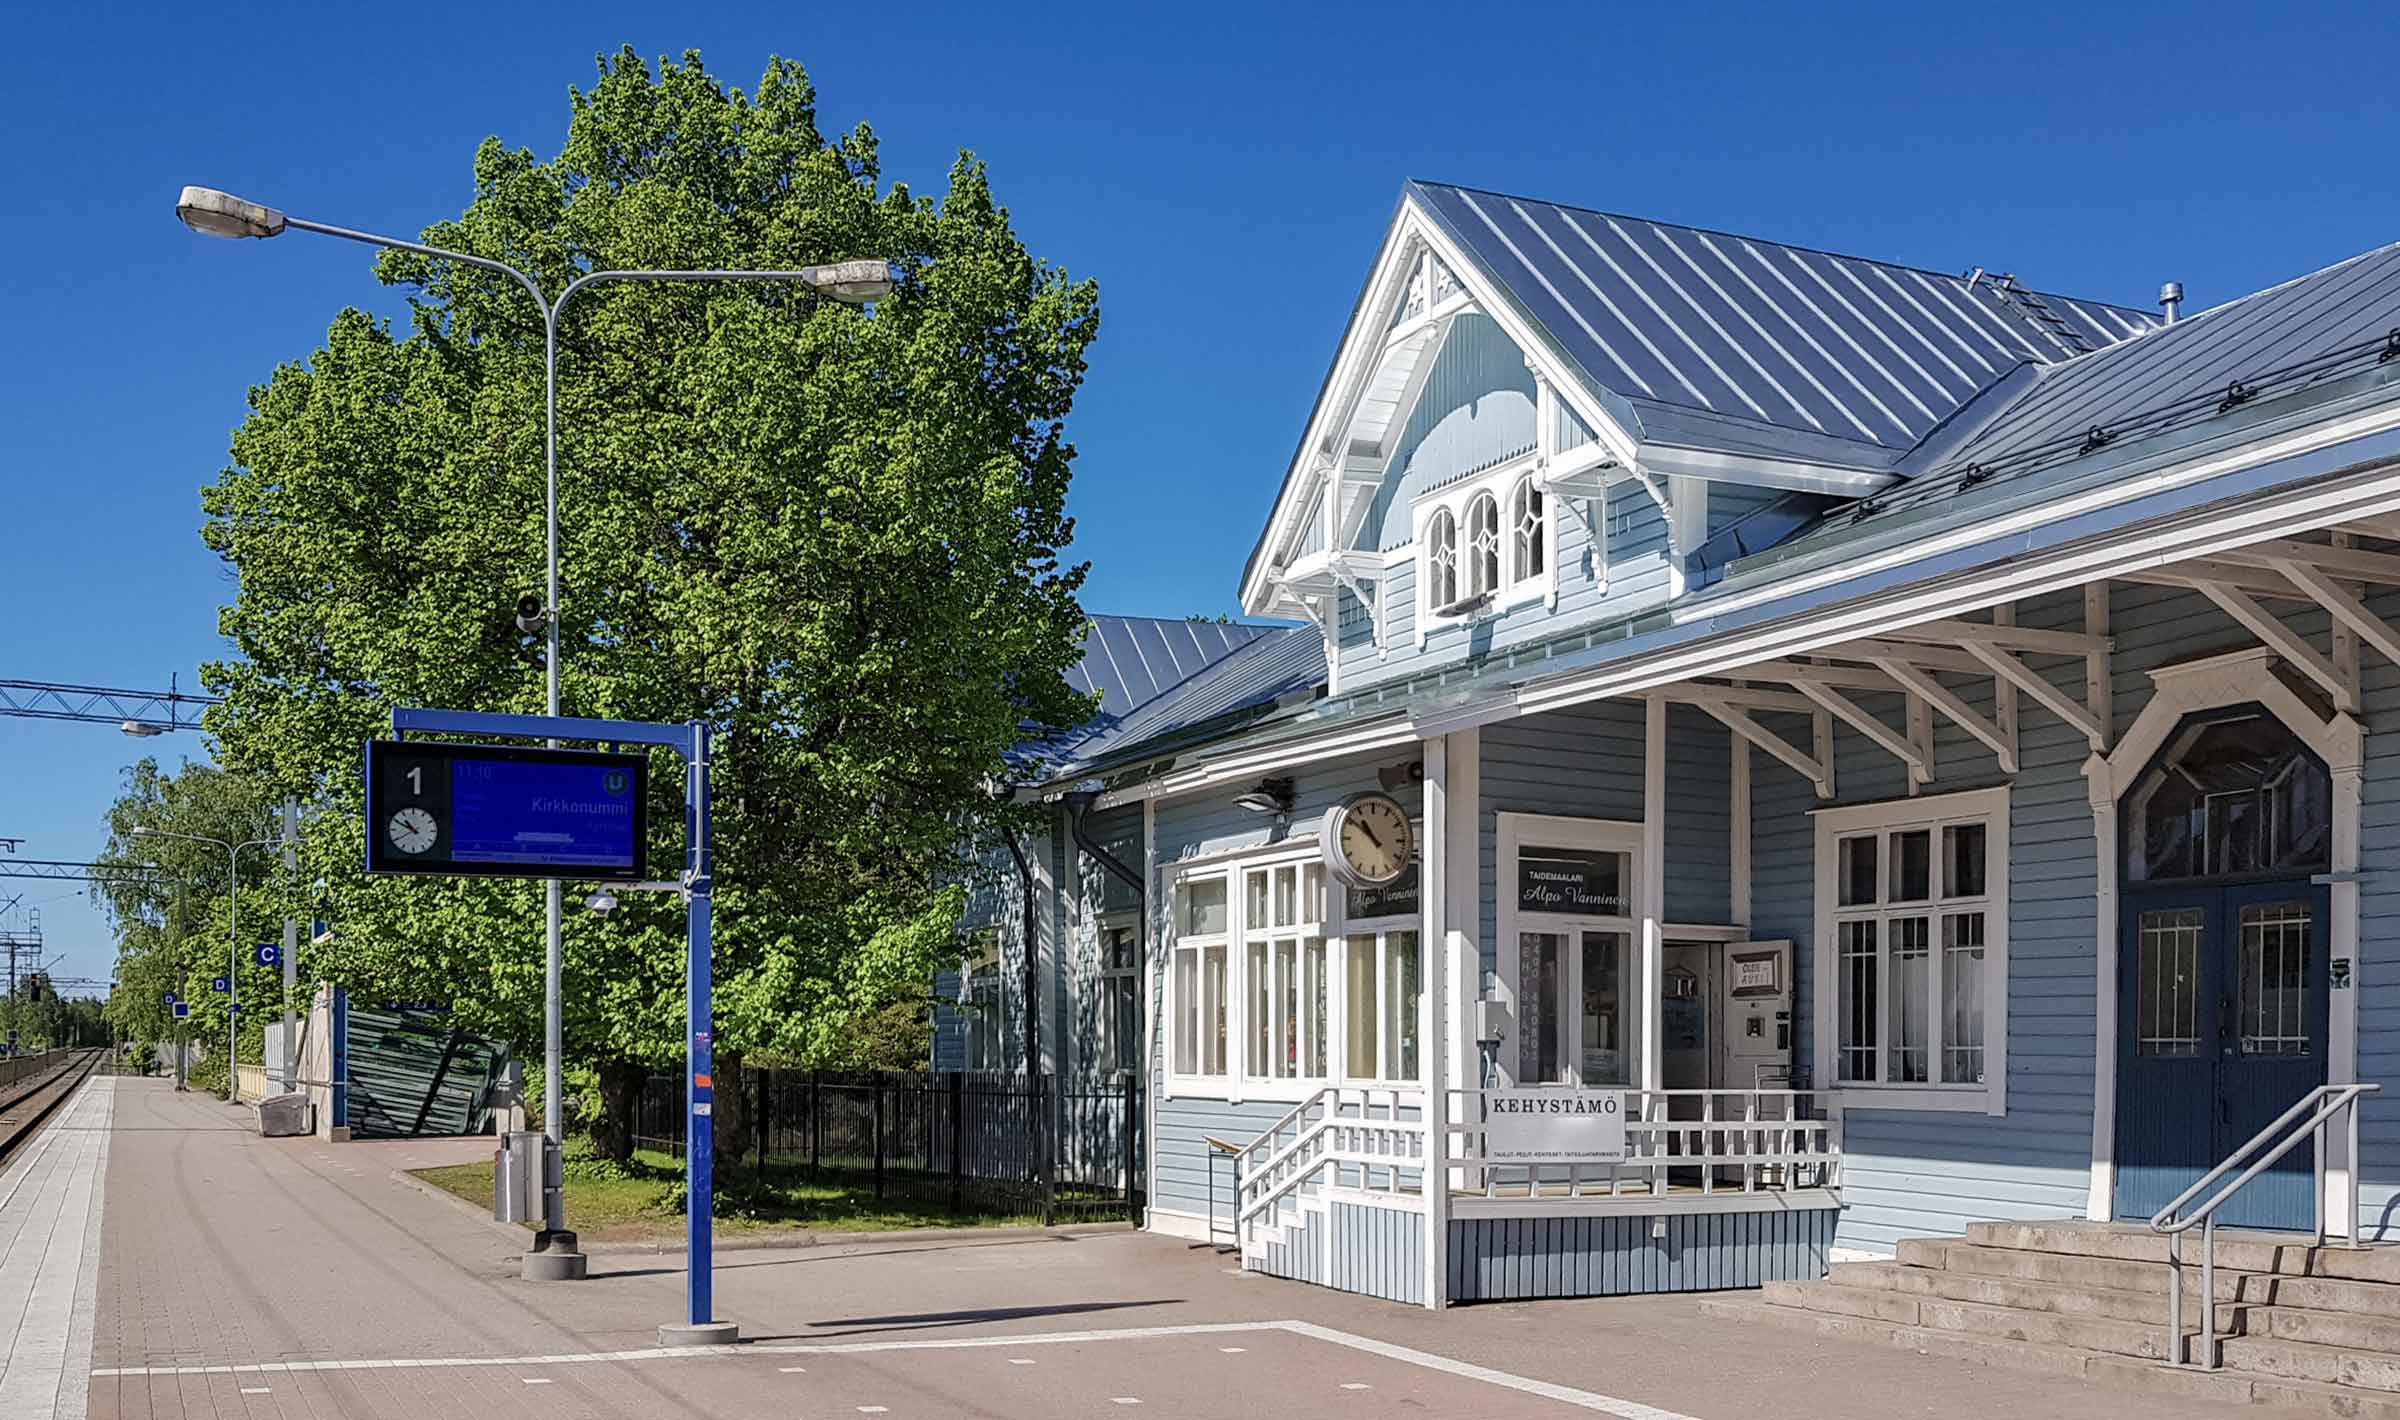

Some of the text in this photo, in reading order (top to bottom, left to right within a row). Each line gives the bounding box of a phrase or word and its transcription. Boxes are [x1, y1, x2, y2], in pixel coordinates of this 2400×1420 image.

[406, 766, 422, 795] 1
[608, 775, 623, 790] U
[531, 797, 628, 816] Kirkkonummi
[1528, 871, 1584, 882] TAIDEMAALARI
[1523, 885, 1627, 905] Alpo Vanninen
[261, 946, 275, 962] C
[215, 979, 225, 991] D
[1493, 1095, 1617, 1114] KEHYSTÄMÖ
